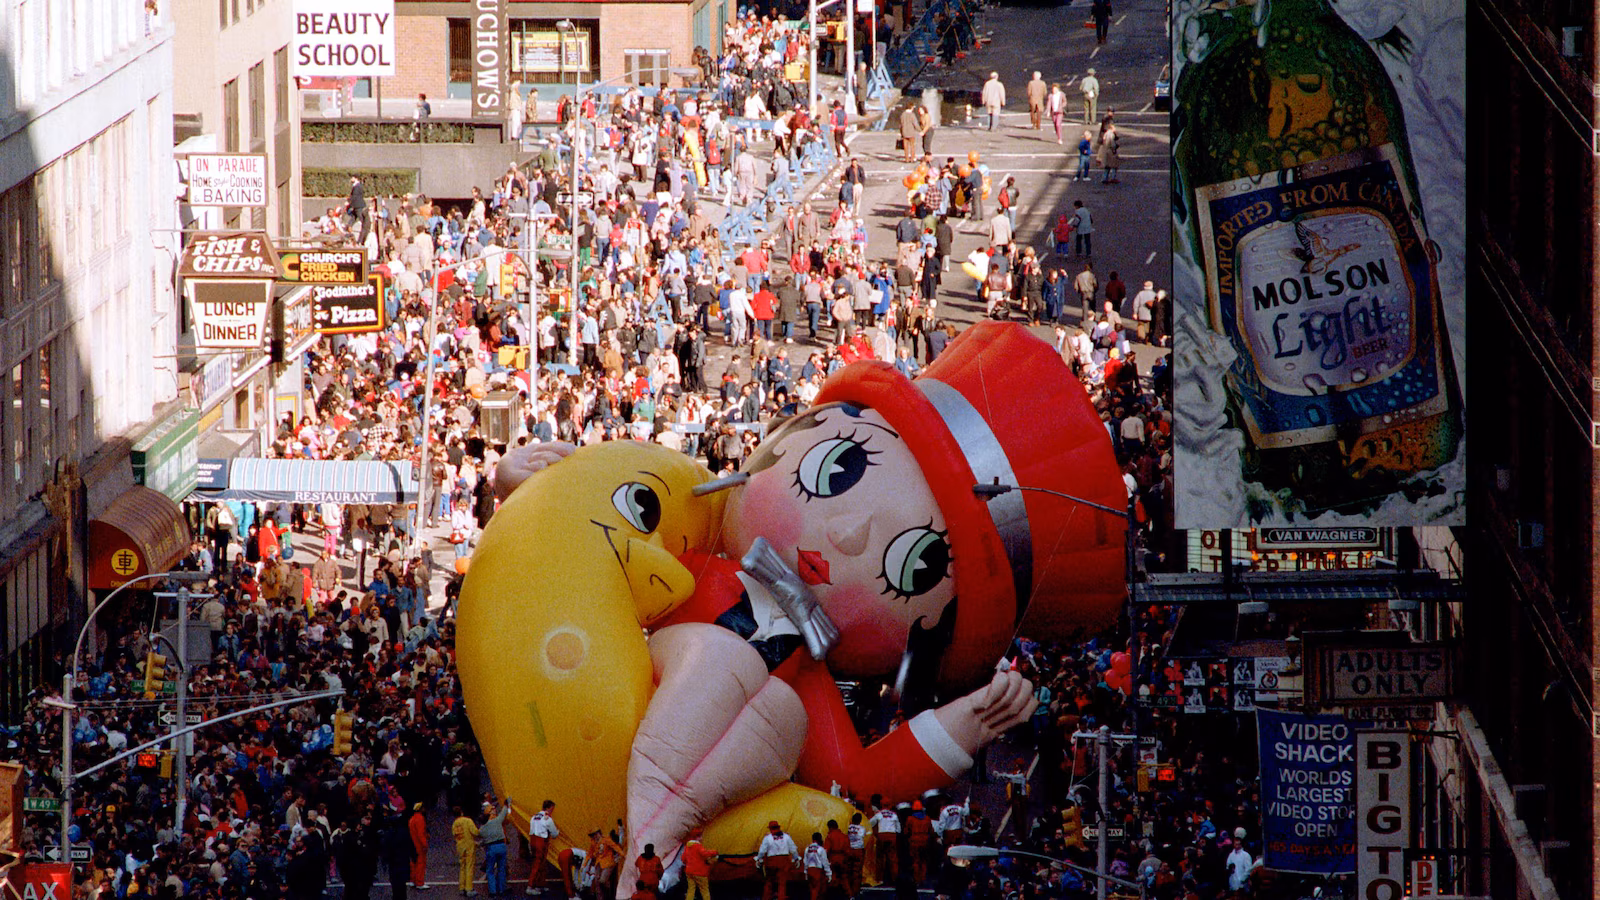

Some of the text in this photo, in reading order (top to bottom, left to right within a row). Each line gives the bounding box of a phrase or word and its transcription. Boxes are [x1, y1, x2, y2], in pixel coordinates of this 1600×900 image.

[296, 13, 390, 34] BEAUTY
[298, 44, 391, 66] SCHOOL
[196, 158, 257, 172] ON PARADE
[192, 173, 212, 188] HOME
[230, 173, 263, 188] COOKING
[203, 189, 262, 203] BAKING
[250, 239, 261, 254] &
[1217, 200, 1273, 296] IMPORTED
[1279, 181, 1348, 210] FROM
[300, 253, 361, 263] CHURCH'S
[300, 262, 338, 272] FRIED
[300, 271, 355, 282] CHICKEN
[1252, 258, 1390, 311] MOLSON
[317, 284, 375, 299] Godfather's
[204, 302, 255, 316] LUNCH
[330, 305, 378, 324] Pizza
[203, 322, 257, 340] DINNER
[1272, 296, 1392, 371] Light
[1354, 338, 1389, 359] BEER
[295, 491, 377, 502] RESTAURANT
[1275, 530, 1366, 541] VAN WAGNER
[115, 550, 135, 575] 車
[1336, 651, 1442, 673] ADULTS
[1352, 673, 1431, 695] ONLY
[1280, 722, 1349, 741] VIDEO
[1274, 742, 1355, 764] SHACK
[1278, 768, 1353, 786] WORLDS
[1276, 785, 1354, 803] LARGEST
[1366, 741, 1402, 835] BIG
[39, 799, 51, 809] 49
[1266, 802, 1356, 821] VIDEO STOR
[1294, 822, 1338, 838] OPEN
